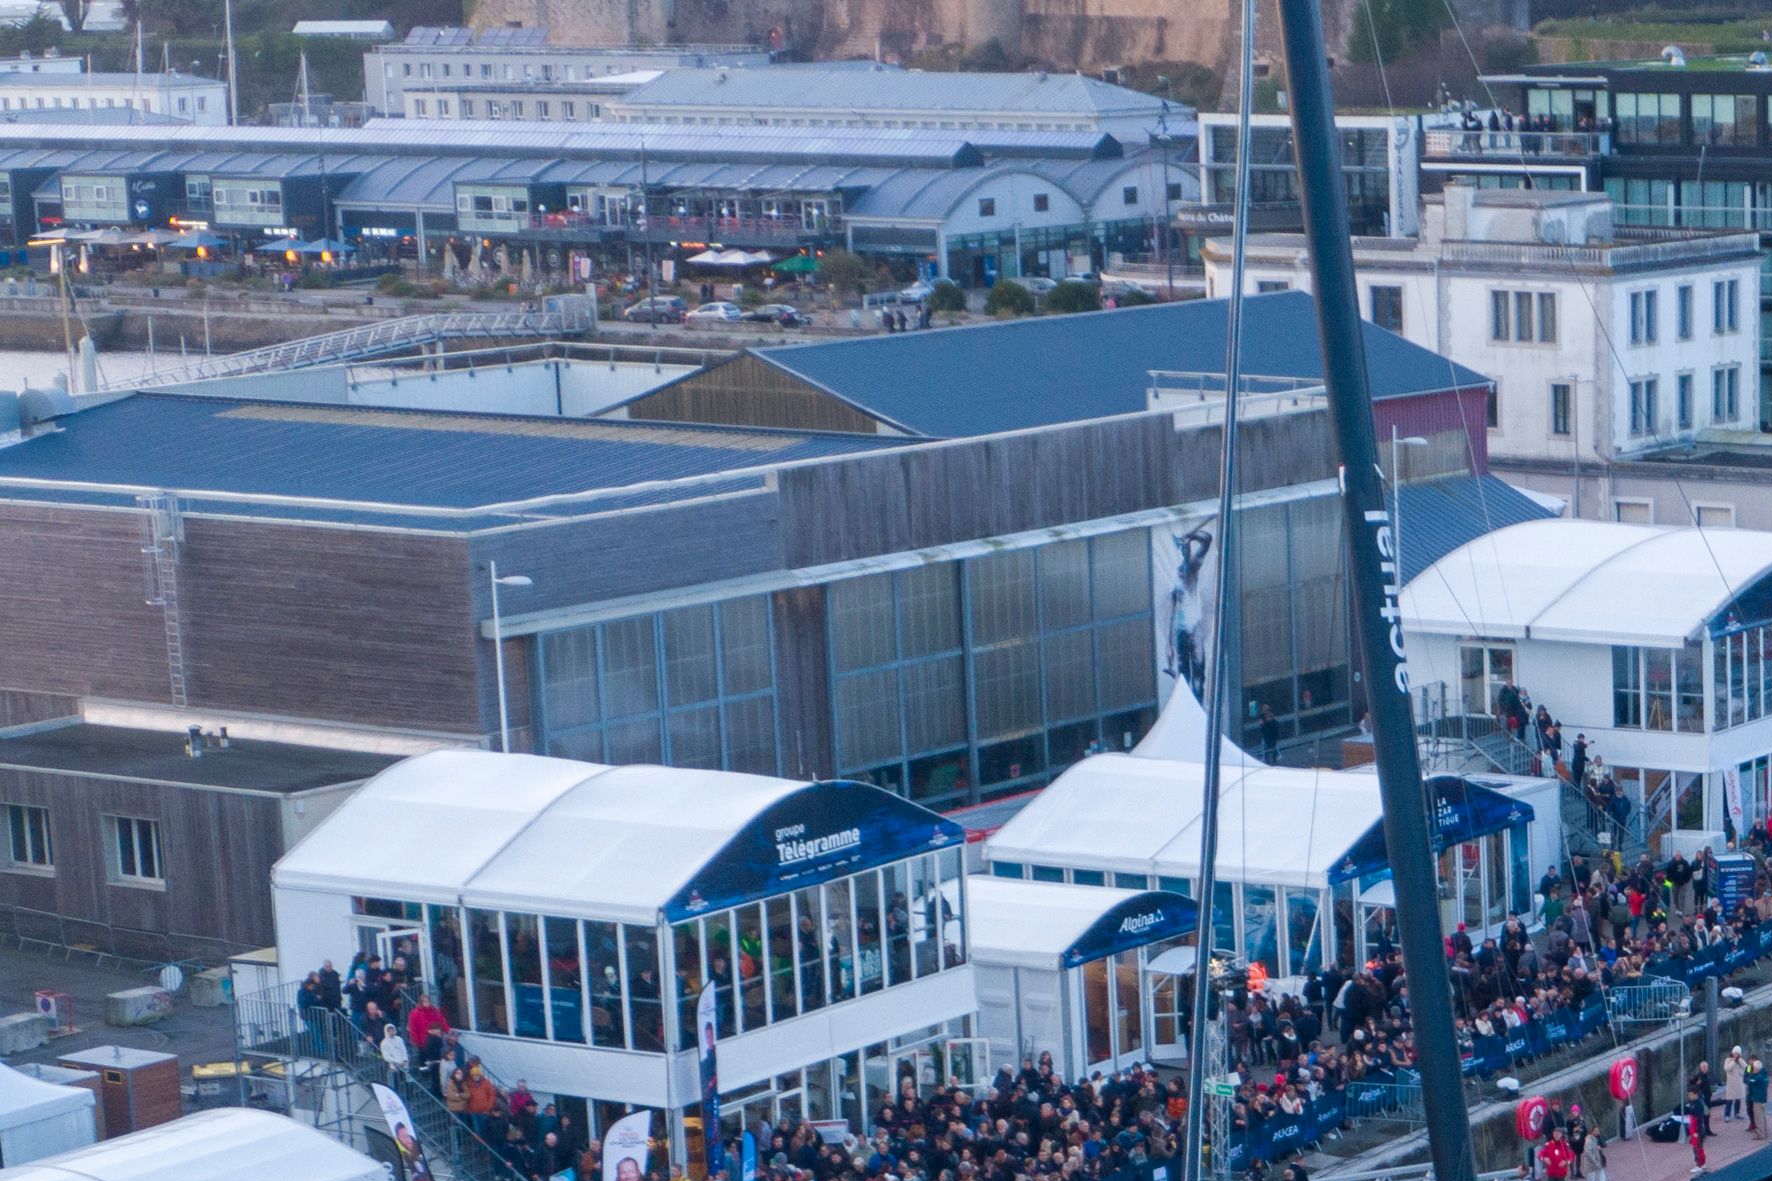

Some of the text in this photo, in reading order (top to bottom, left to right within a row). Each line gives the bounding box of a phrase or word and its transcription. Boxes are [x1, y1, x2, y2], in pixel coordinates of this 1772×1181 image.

[1437, 798, 1447, 808] LA
[775, 823, 806, 842] groupe
[775, 826, 861, 862] Télégramme
[1119, 911, 1155, 934] Alpina
